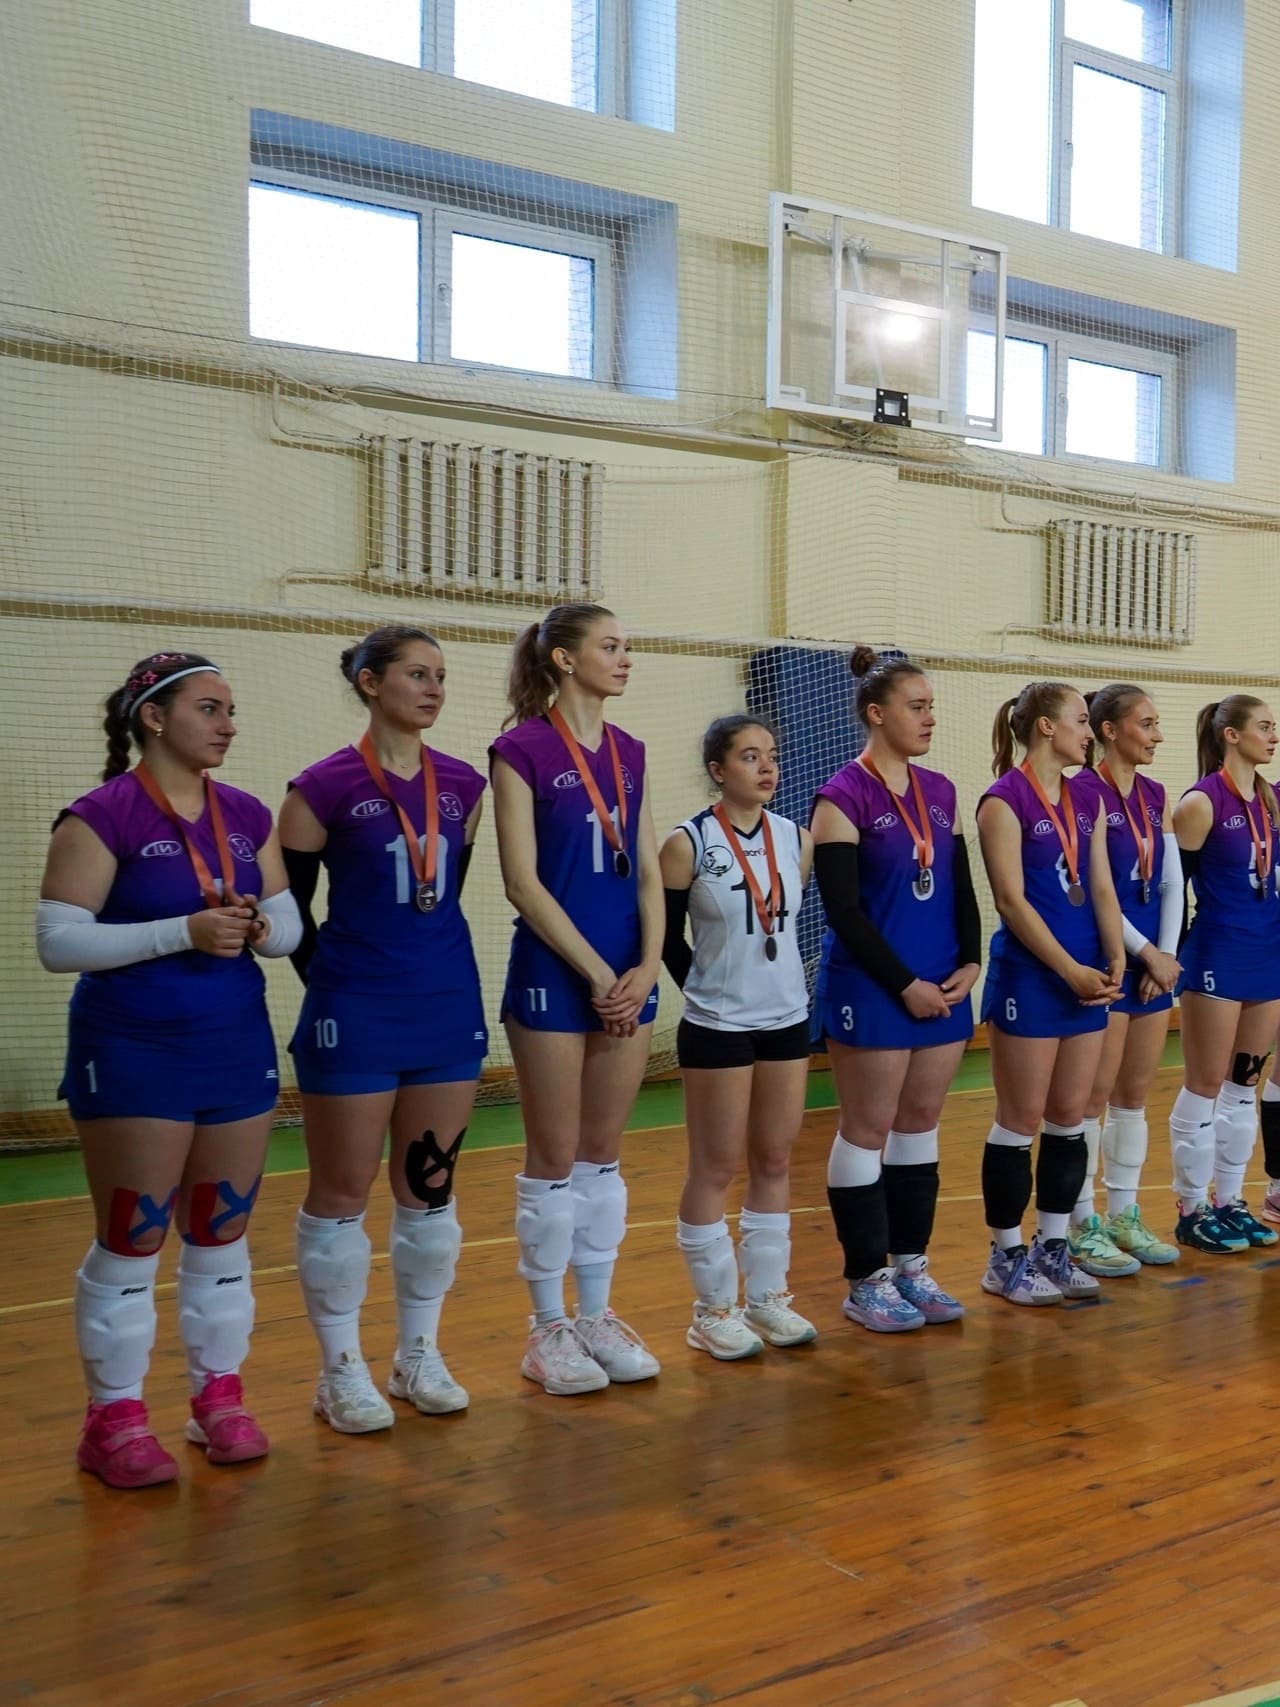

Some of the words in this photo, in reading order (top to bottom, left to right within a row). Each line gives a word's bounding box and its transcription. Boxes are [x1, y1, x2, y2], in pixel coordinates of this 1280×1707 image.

[742, 847, 766, 857] acro
[385, 834, 448, 904] 10
[731, 872, 789, 935] 14
[1203, 970, 1216, 992] 5
[526, 988, 548, 1012] 11
[1005, 997, 1018, 1021] 6
[841, 1005, 854, 1031] 3
[314, 1018, 339, 1049] 10
[85, 1060, 98, 1093] 1
